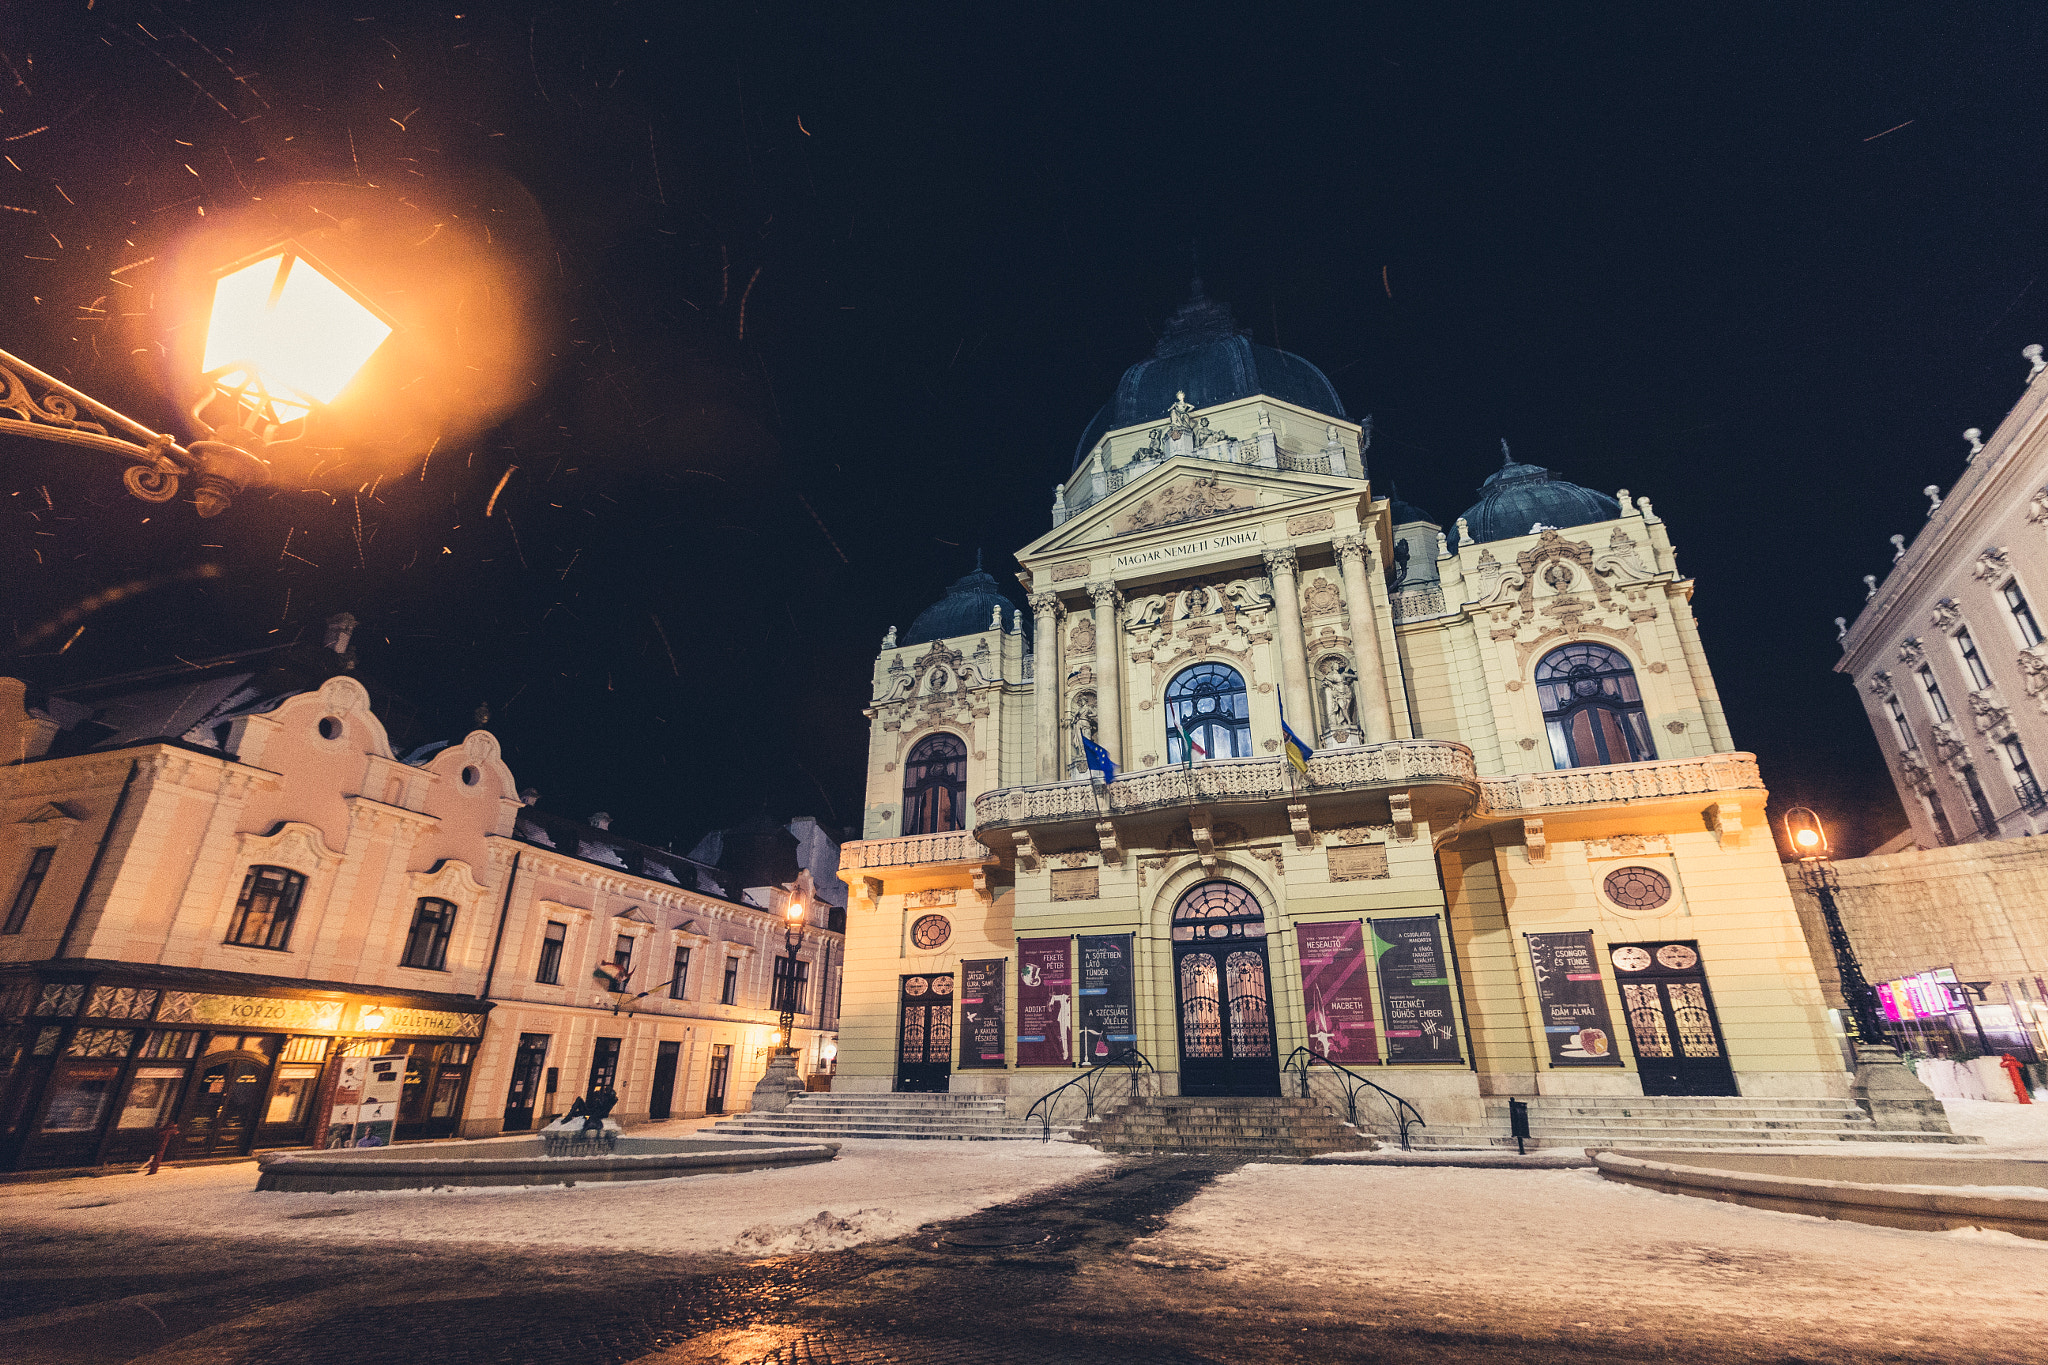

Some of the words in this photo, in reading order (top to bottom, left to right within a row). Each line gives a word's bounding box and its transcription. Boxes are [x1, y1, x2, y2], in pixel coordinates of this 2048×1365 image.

[1117, 551, 1161, 567] MAGYAR
[1164, 540, 1208, 557] NEMZETI
[1555, 949, 1588, 958] CSONGOR
[1046, 961, 1065, 970] PÉTER
[1554, 958, 1564, 966] ÉS
[1331, 1001, 1364, 1010] MACBETH
[1390, 998, 1426, 1009] TIZENKÉT
[1024, 1005, 1047, 1013] ADDIKT
[1088, 1009, 1094, 1017] A
[1391, 1008, 1416, 1018] DÜHÖS
[1419, 1009, 1443, 1018] EMBER
[1551, 1007, 1570, 1016] ÁDÁM
[1572, 1006, 1596, 1016] ALMÁI
